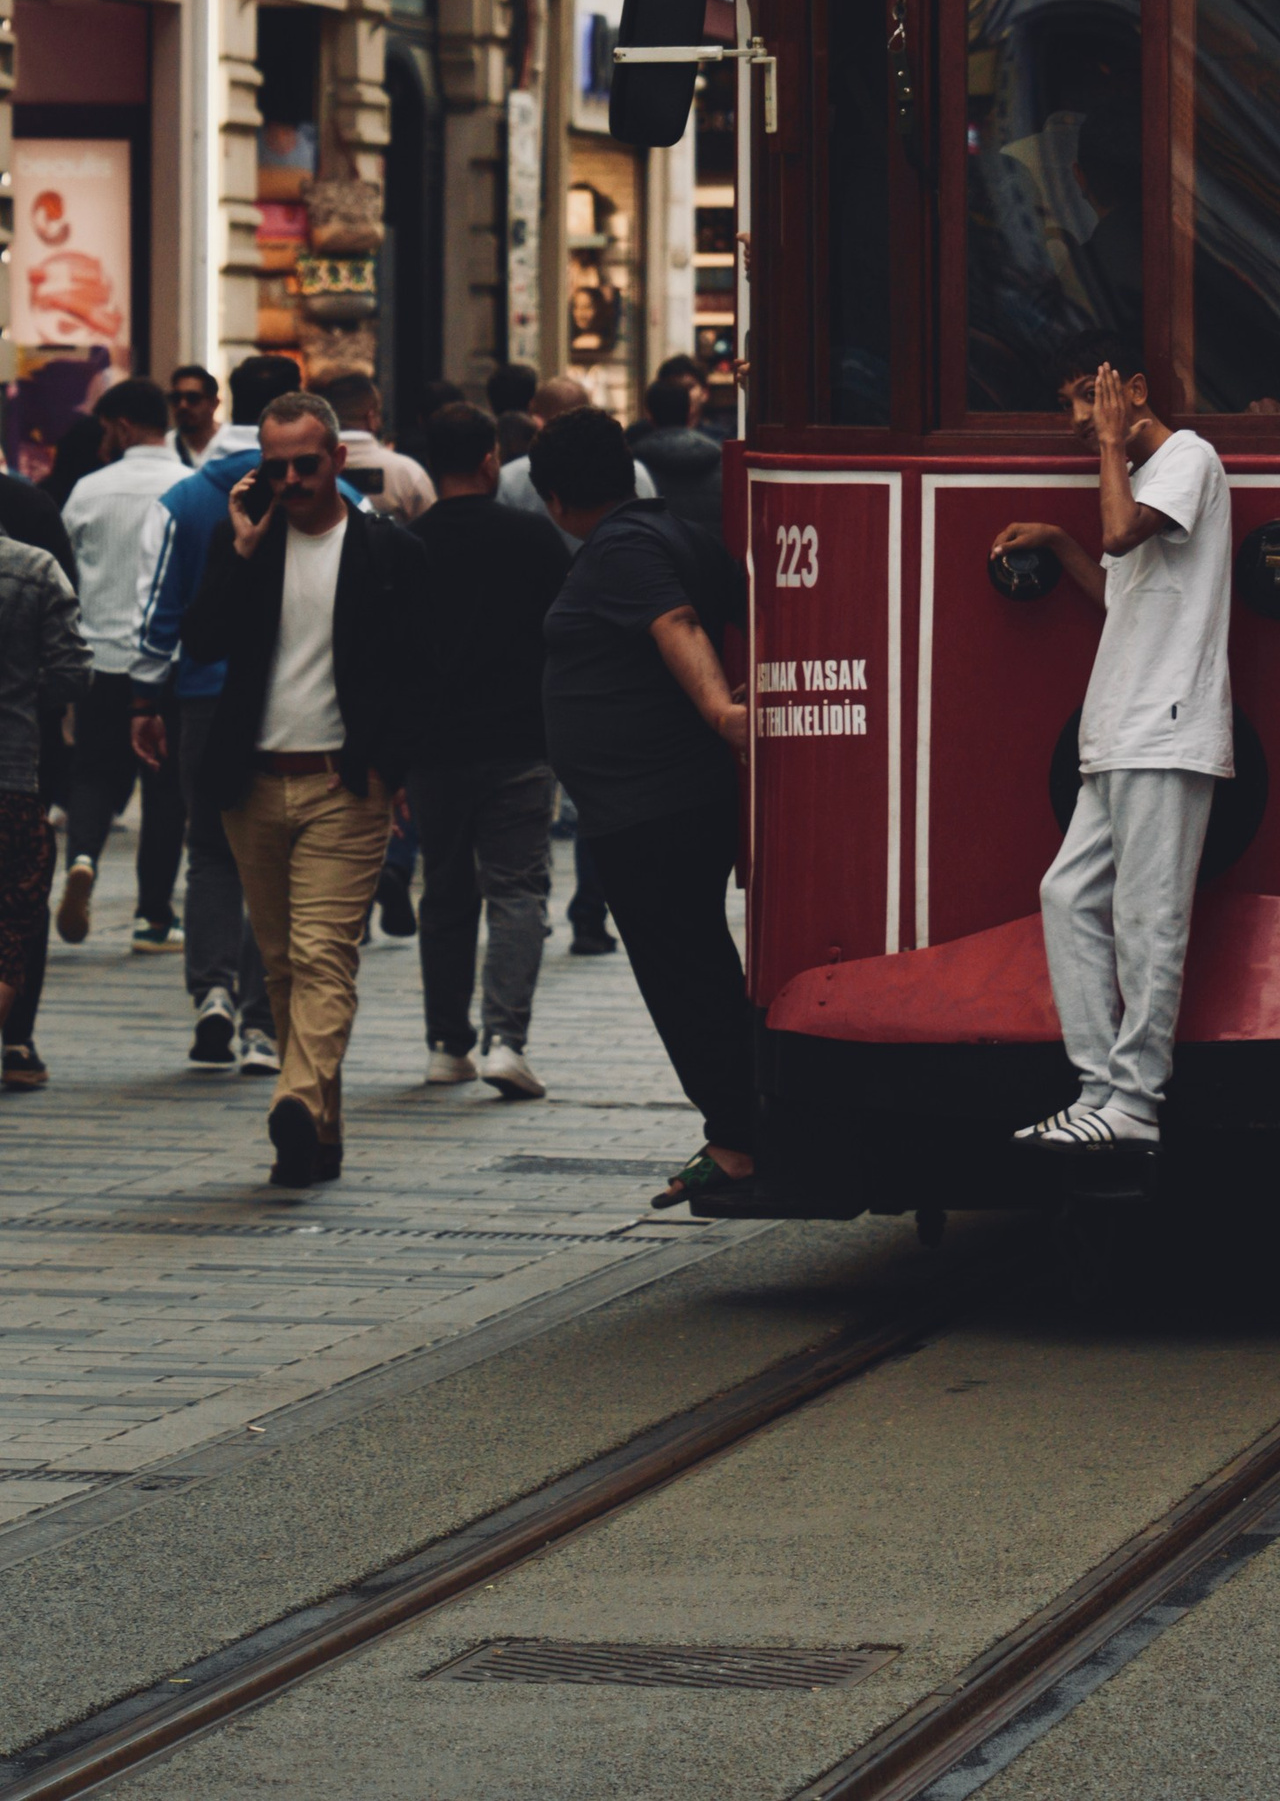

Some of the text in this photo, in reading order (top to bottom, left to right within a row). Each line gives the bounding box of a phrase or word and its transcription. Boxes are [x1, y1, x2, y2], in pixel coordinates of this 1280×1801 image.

[775, 524, 819, 589] 223
[801, 658, 868, 692] YASAK
[765, 698, 868, 738] TEHLİKELİDİR
